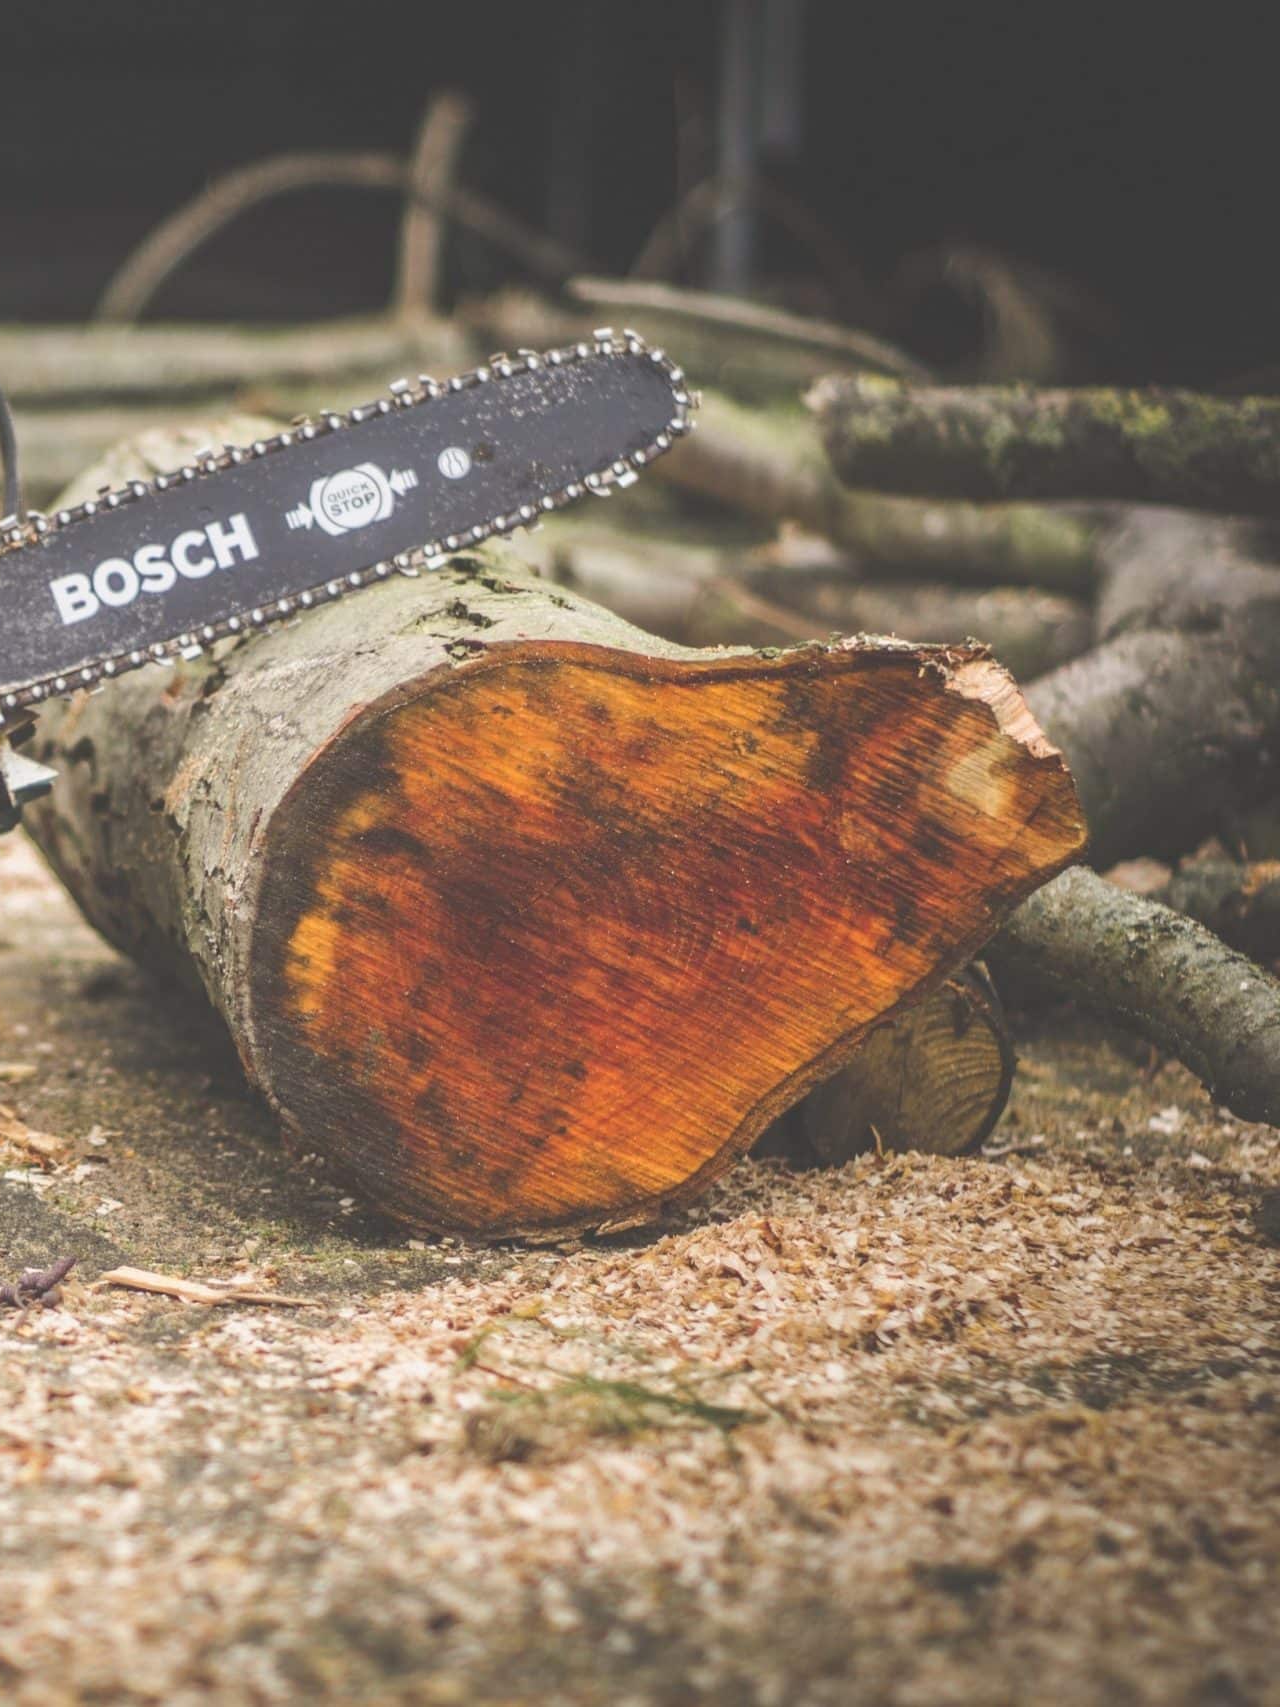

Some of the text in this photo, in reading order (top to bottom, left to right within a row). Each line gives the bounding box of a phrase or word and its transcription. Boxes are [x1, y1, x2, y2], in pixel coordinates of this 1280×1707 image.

[327, 482, 371, 503] QUICK
[329, 491, 375, 516] STOP
[49, 512, 260, 626] BOSCH
